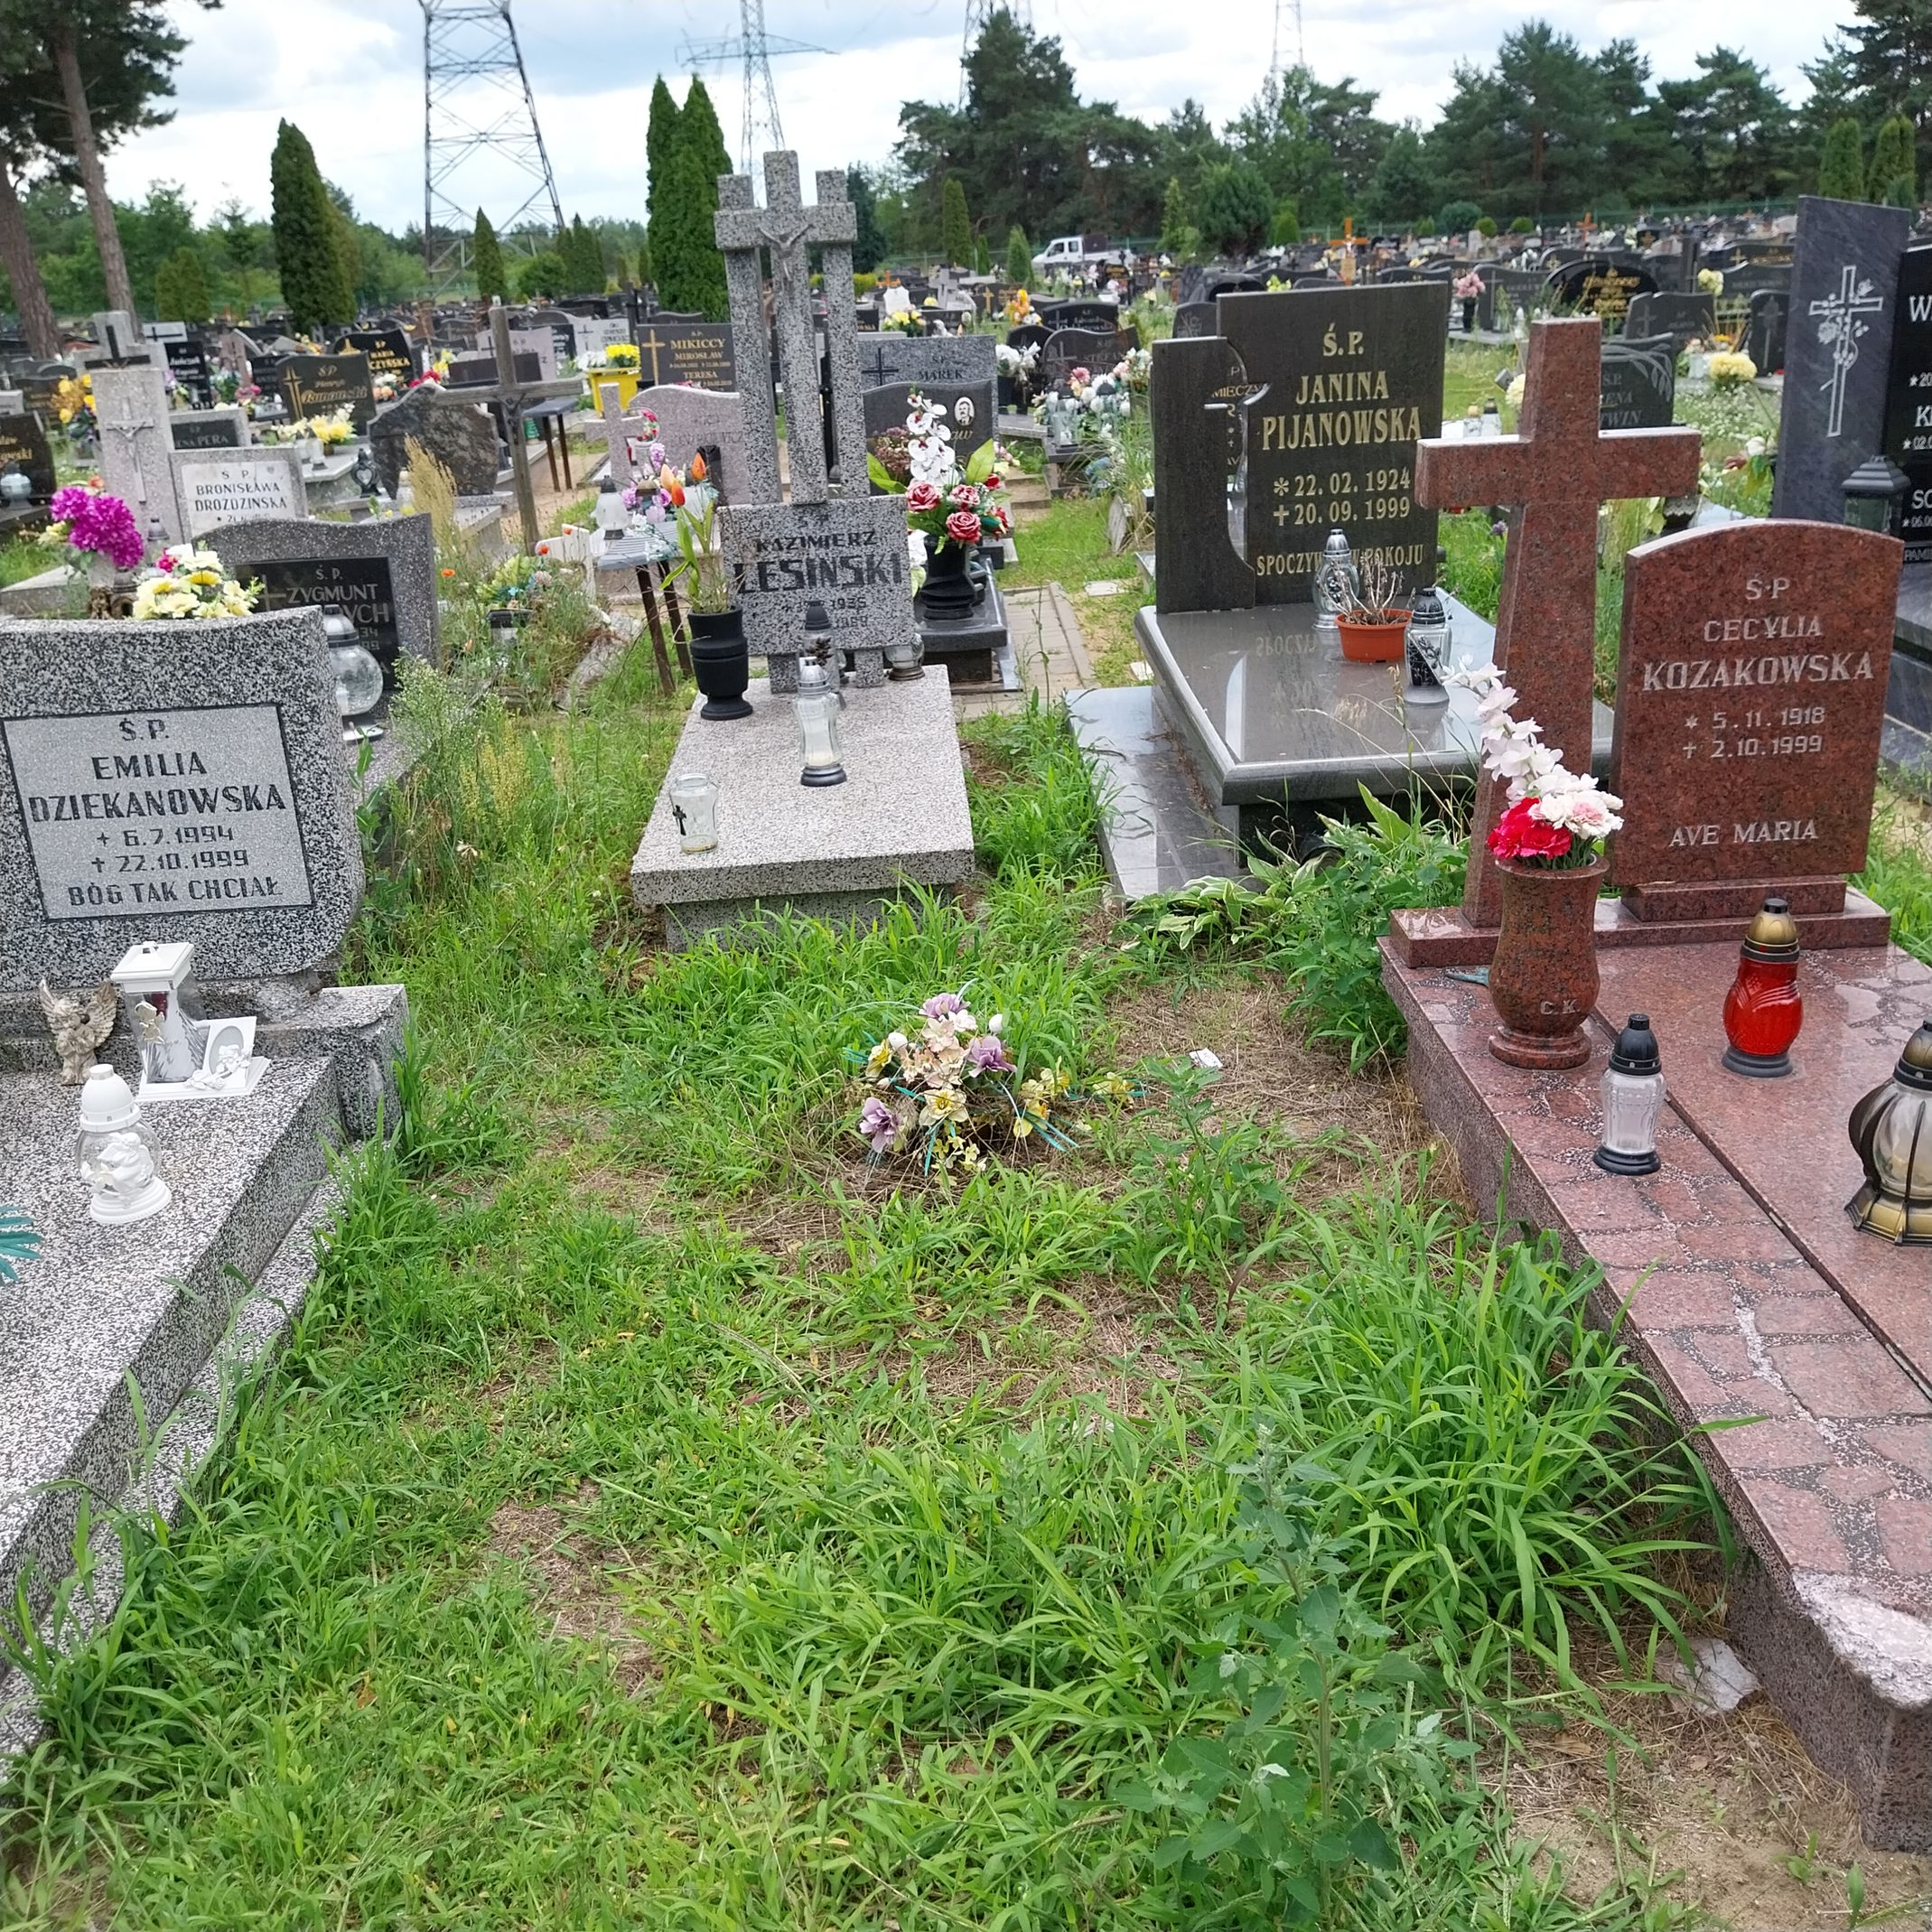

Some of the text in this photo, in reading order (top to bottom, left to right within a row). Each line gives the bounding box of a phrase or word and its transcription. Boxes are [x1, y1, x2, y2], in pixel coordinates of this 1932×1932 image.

[1296, 370, 1389, 405] JANINA
[1262, 407, 1422, 451] PIJANOWSKA
[196, 482, 280, 496] BRONISŁAWA
[756, 531, 877, 552] KAZIMIERZ
[286, 583, 378, 603] ZYGMUNT
[1703, 615, 1822, 642] CECYLIA
[1642, 652, 1875, 692] KOZAKOWSKA
[91, 751, 208, 779] EMILIA
[29, 784, 287, 823] DZIEKANOWSKA
[1668, 824, 1720, 847] AVE
[1733, 819, 1819, 844] MARIA
[69, 876, 284, 906] BÓG TAK CHCIAŁ
